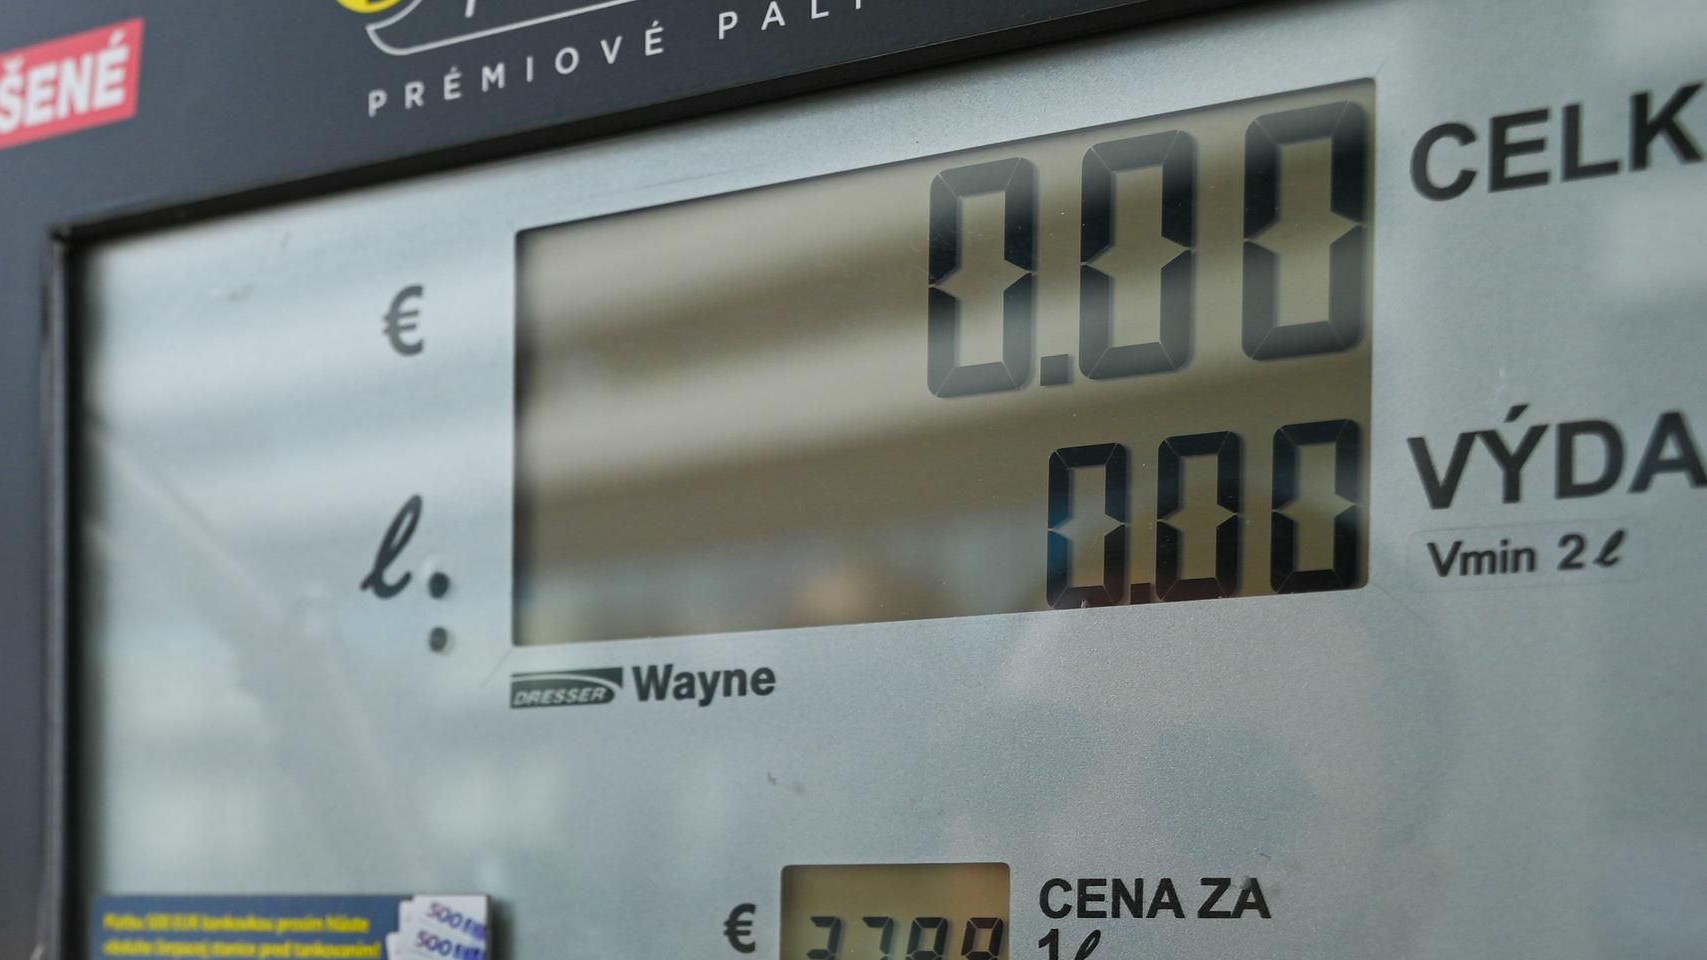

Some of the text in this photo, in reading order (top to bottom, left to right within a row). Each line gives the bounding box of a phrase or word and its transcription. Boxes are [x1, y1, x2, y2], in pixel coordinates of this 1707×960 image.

[368, 20, 664, 117] PRÉMIOVÉ
[927, 100, 1369, 399] 0.00
[382, 284, 425, 356] €
[1046, 419, 1361, 610] 0.00
[1427, 538, 1537, 577] Vmin
[513, 663, 777, 708] DRESSER Wayne
[426, 901, 463, 929] 500
[1038, 877, 1272, 919] CENA ZA
[415, 930, 453, 957] 500
[723, 903, 756, 954] €
